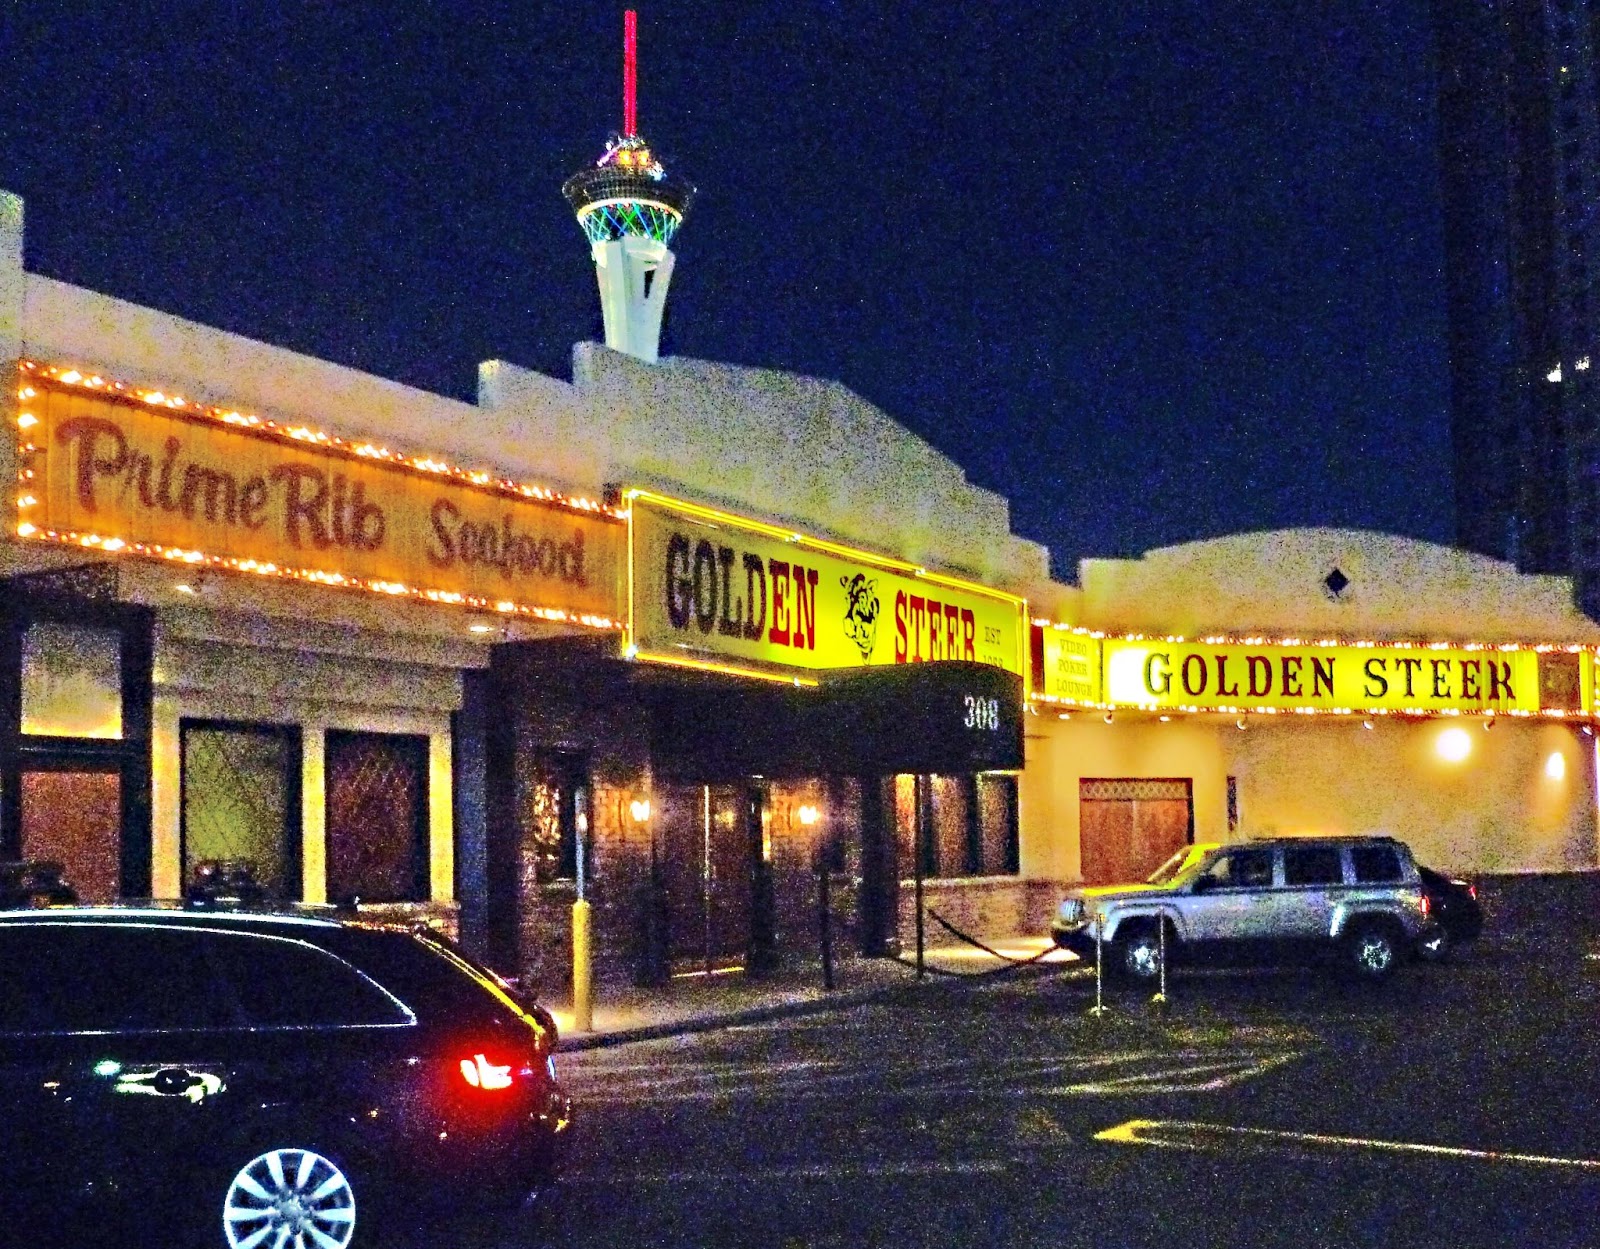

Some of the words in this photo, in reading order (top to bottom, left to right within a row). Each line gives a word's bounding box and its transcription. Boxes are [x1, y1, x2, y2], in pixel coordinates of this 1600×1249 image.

[55, 416, 270, 529] Prime
[271, 462, 387, 551] Rib
[427, 500, 586, 588] Seafood
[667, 533, 818, 650] GOLDEN
[895, 590, 975, 664] STEER
[1058, 659, 1088, 676] POKER
[1060, 639, 1087, 656] VIDEO
[1056, 679, 1093, 697] LOUNGE
[1145, 652, 1336, 698] GOLDEN
[1363, 658, 1517, 700] STEER
[964, 695, 999, 730] 308
